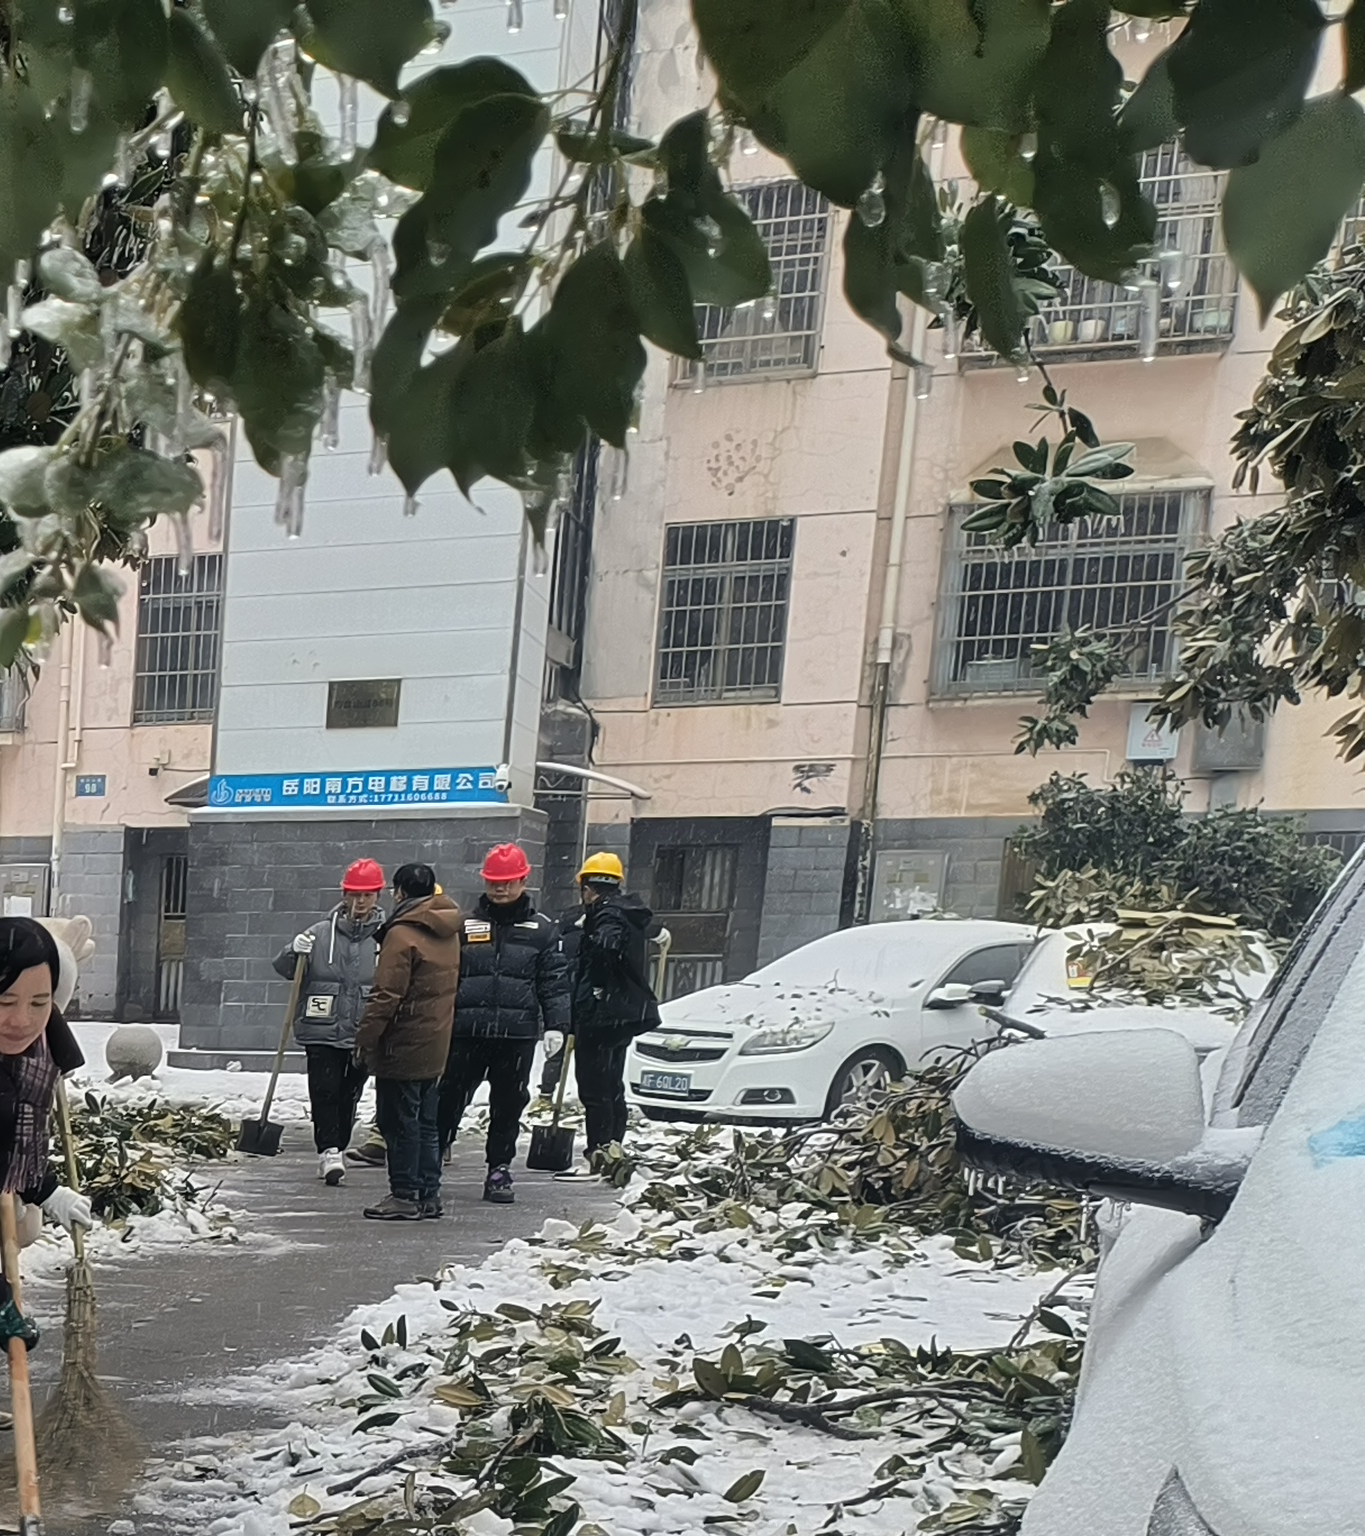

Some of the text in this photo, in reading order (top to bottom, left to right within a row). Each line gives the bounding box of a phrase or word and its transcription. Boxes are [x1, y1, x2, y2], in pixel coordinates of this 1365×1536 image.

[282, 772, 496, 796] 岳阳南方电梯有限公司
